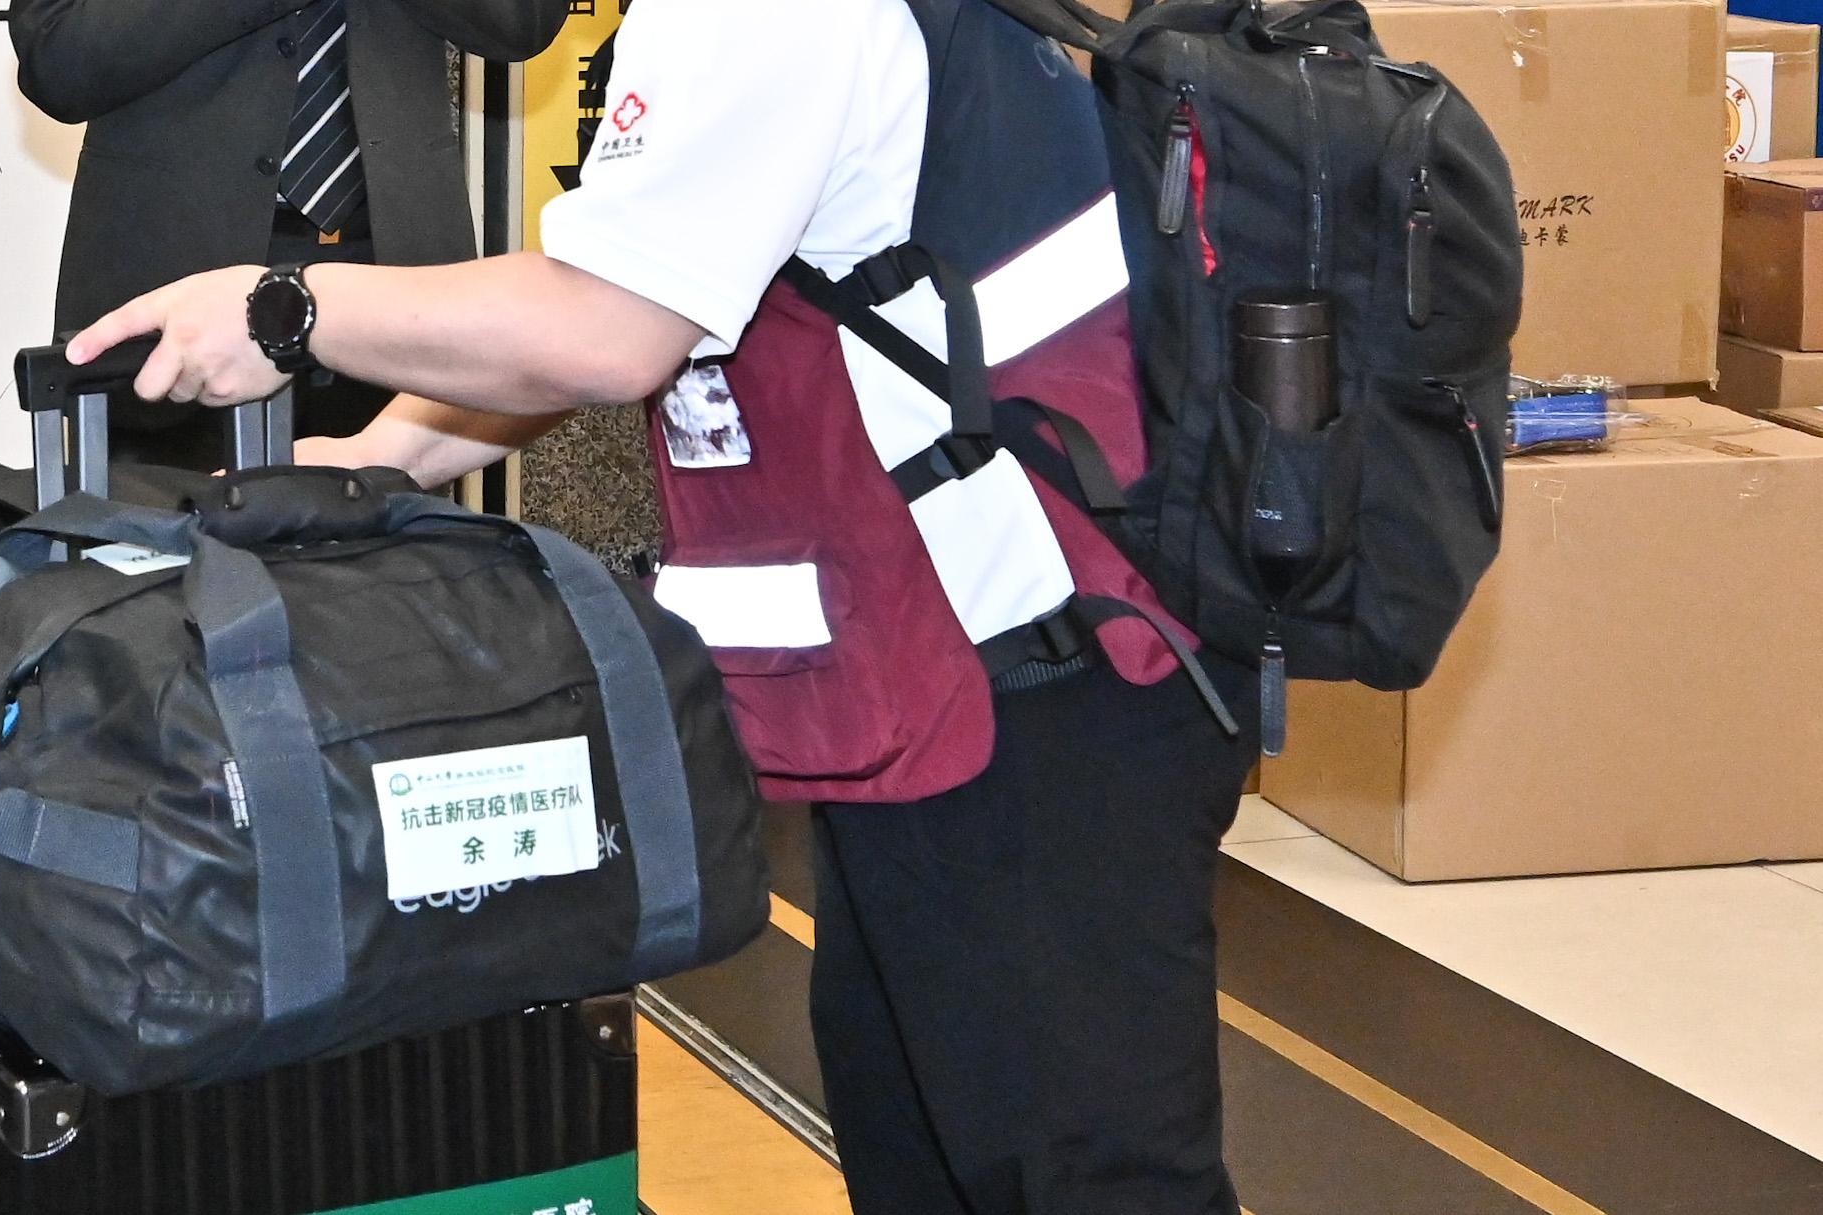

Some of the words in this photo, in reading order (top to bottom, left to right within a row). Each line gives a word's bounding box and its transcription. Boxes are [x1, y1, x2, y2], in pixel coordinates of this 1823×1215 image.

[1518, 194, 1594, 219] MARK
[400, 784, 583, 831] 抗击新冠疫情医疗队
[462, 835, 486, 865] 余
